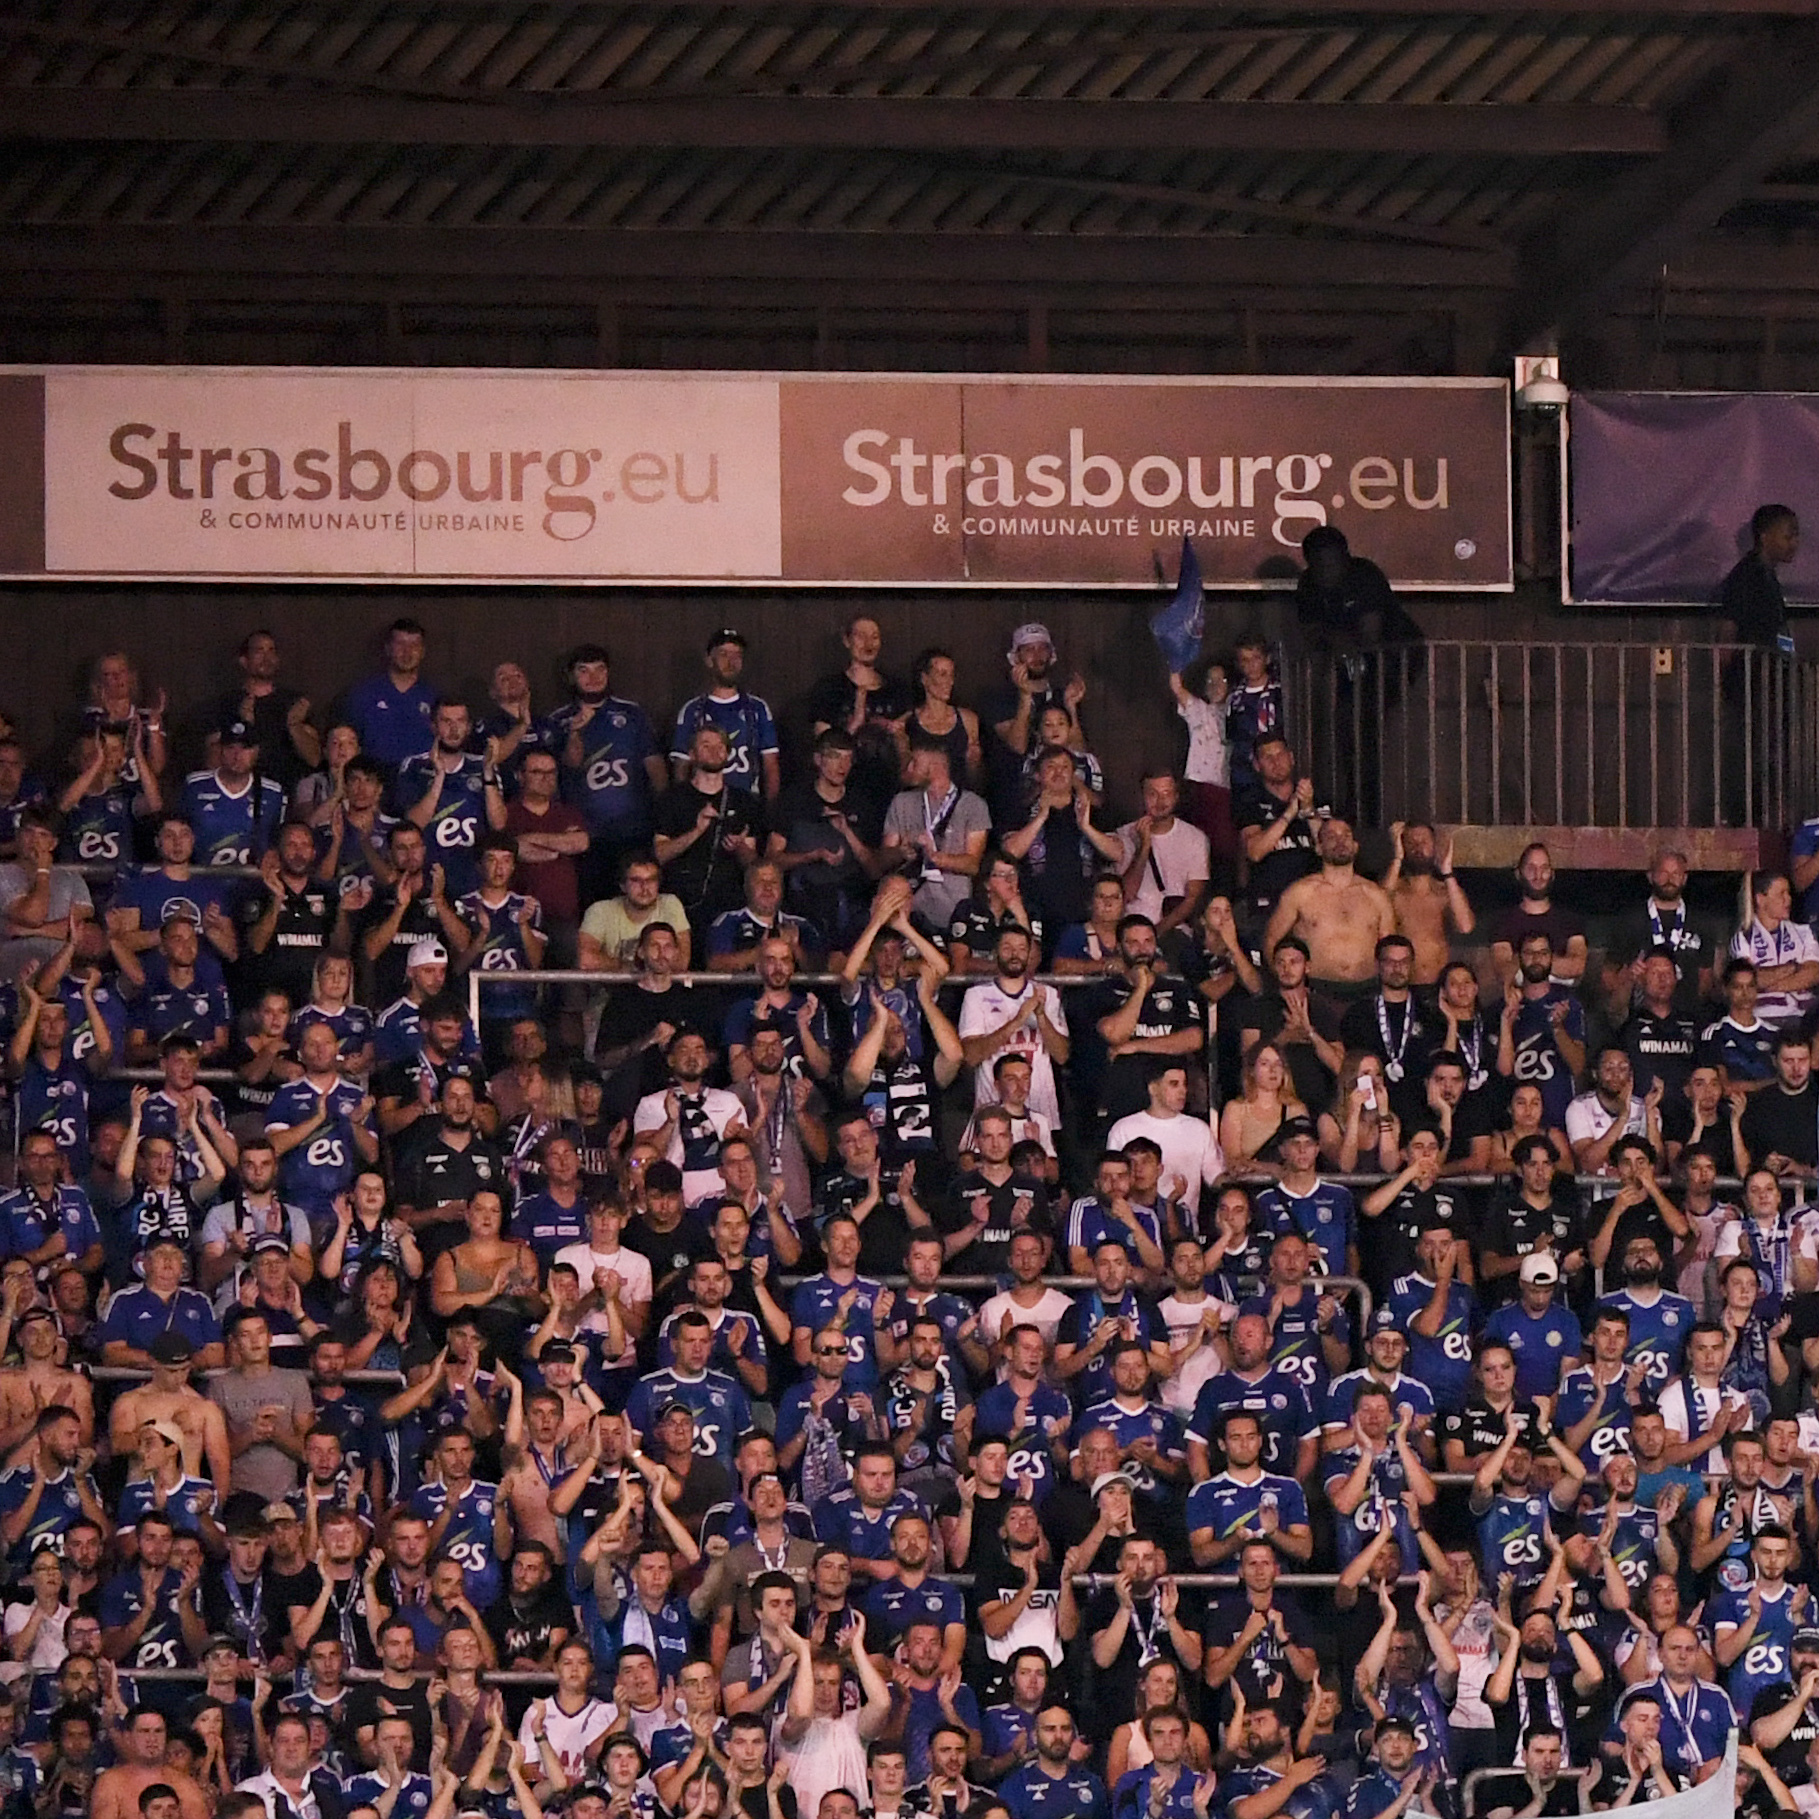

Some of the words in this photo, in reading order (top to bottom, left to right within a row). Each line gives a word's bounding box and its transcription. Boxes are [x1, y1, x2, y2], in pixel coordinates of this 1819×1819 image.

[107, 421, 721, 541] Strasbourg.eu
[842, 427, 1450, 547] Strasbourg.eu
[199, 508, 217, 530] &
[228, 509, 408, 532] COMMUNAUTÉ
[417, 514, 525, 533] URBAINE
[932, 513, 951, 536] &
[961, 514, 1141, 538] COMMUNAUTÉ
[1150, 519, 1256, 538] URBAINE
[588, 758, 628, 788] es
[83, 830, 118, 859] es
[436, 816, 477, 845] es
[1515, 1050, 1554, 1080] es
[307, 1136, 343, 1166] es
[1006, 1449, 1045, 1479] es
[1502, 1530, 1540, 1566] es
[1745, 1642, 1784, 1675] es
